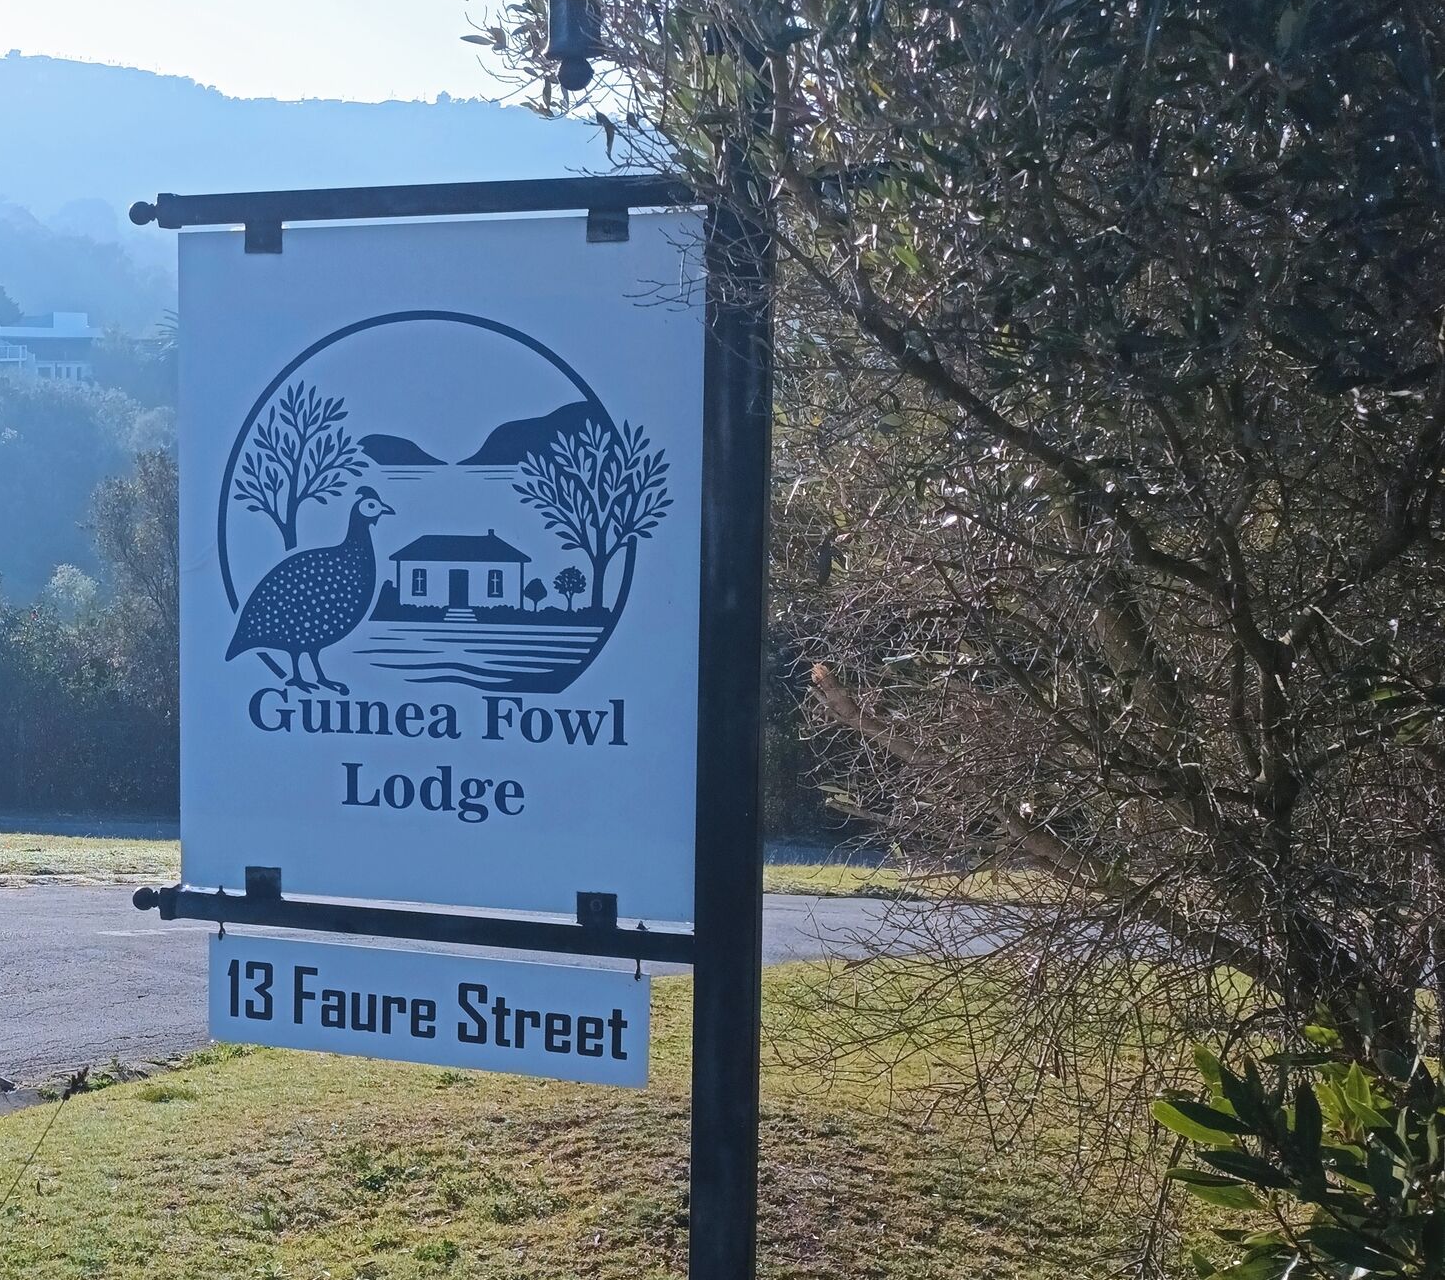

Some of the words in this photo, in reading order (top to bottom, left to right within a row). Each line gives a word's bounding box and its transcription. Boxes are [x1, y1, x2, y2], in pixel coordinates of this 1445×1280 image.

[248, 687, 462, 740] Guinea
[481, 695, 630, 747] Fowl
[341, 762, 526, 824] Lodge
[227, 958, 274, 1021] 13
[293, 965, 437, 1039] Faure
[457, 982, 628, 1061] Street
